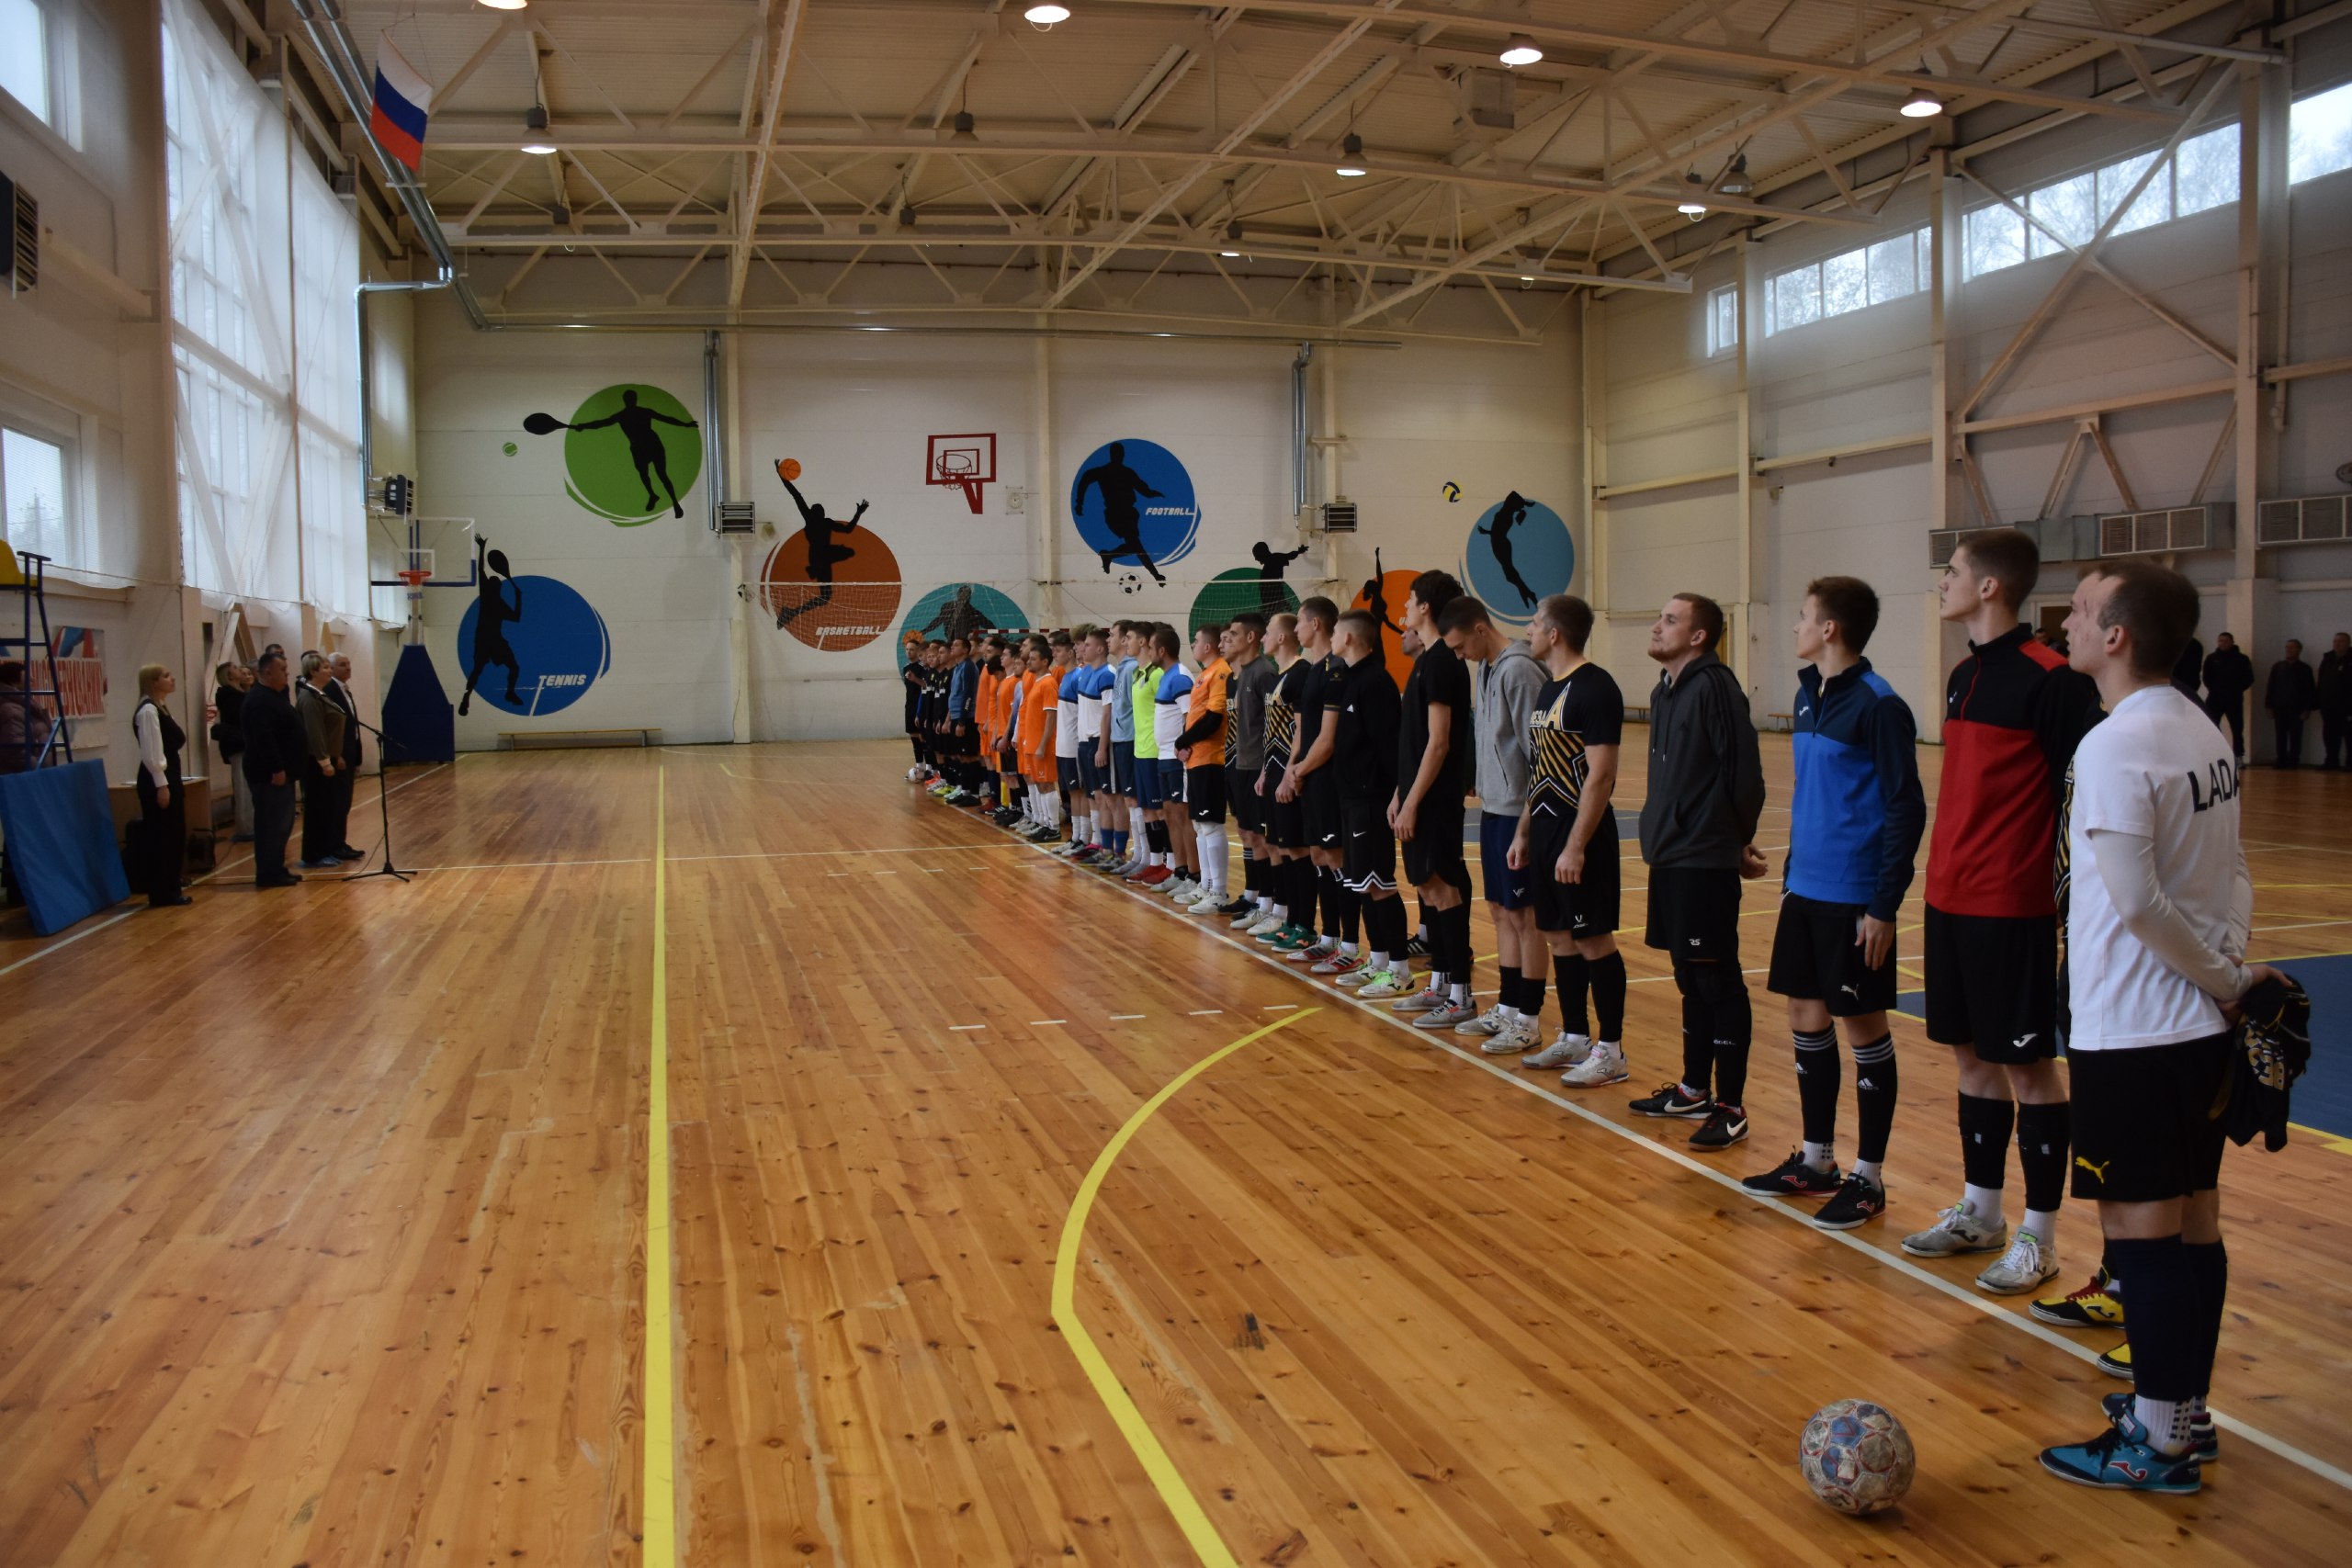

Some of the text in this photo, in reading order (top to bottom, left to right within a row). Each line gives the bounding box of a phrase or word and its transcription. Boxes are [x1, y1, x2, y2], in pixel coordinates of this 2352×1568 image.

[1145, 507, 1194, 515] FOOTBALL
[815, 626, 883, 636] BASKETBALL
[538, 674, 586, 686] TENNIS
